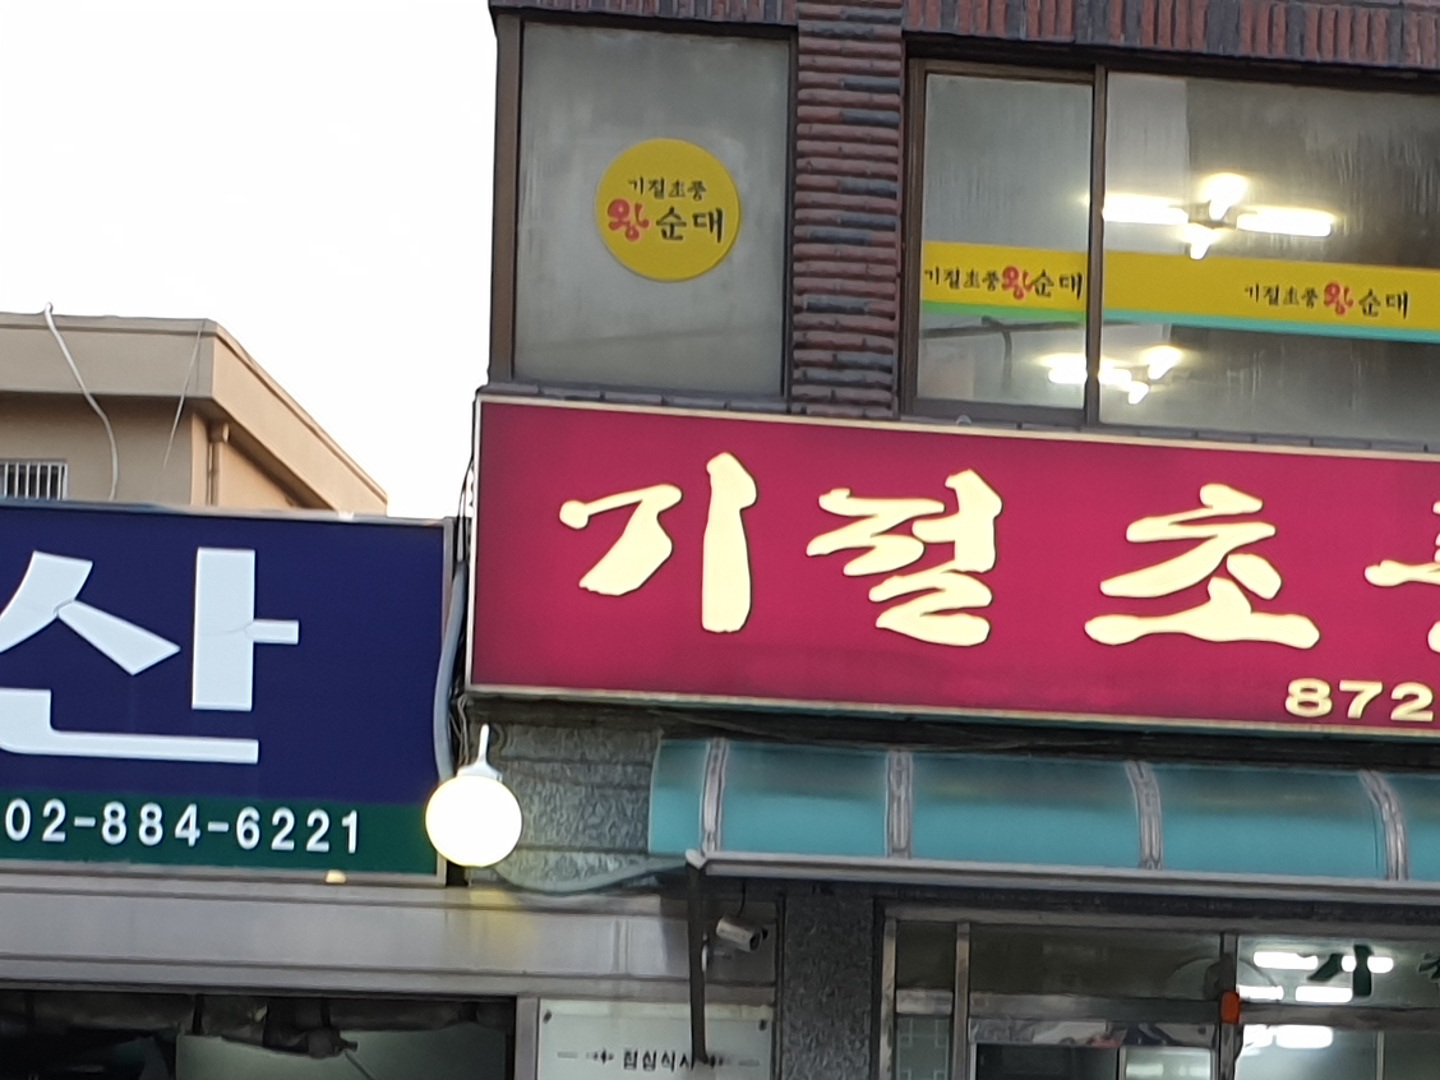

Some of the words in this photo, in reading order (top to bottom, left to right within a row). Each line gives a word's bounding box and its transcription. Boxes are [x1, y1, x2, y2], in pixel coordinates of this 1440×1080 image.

[628, 175, 707, 201] 기절초풍
[606, 197, 724, 244] 왕순대
[4, 797, 360, 855] 02-884-6221
